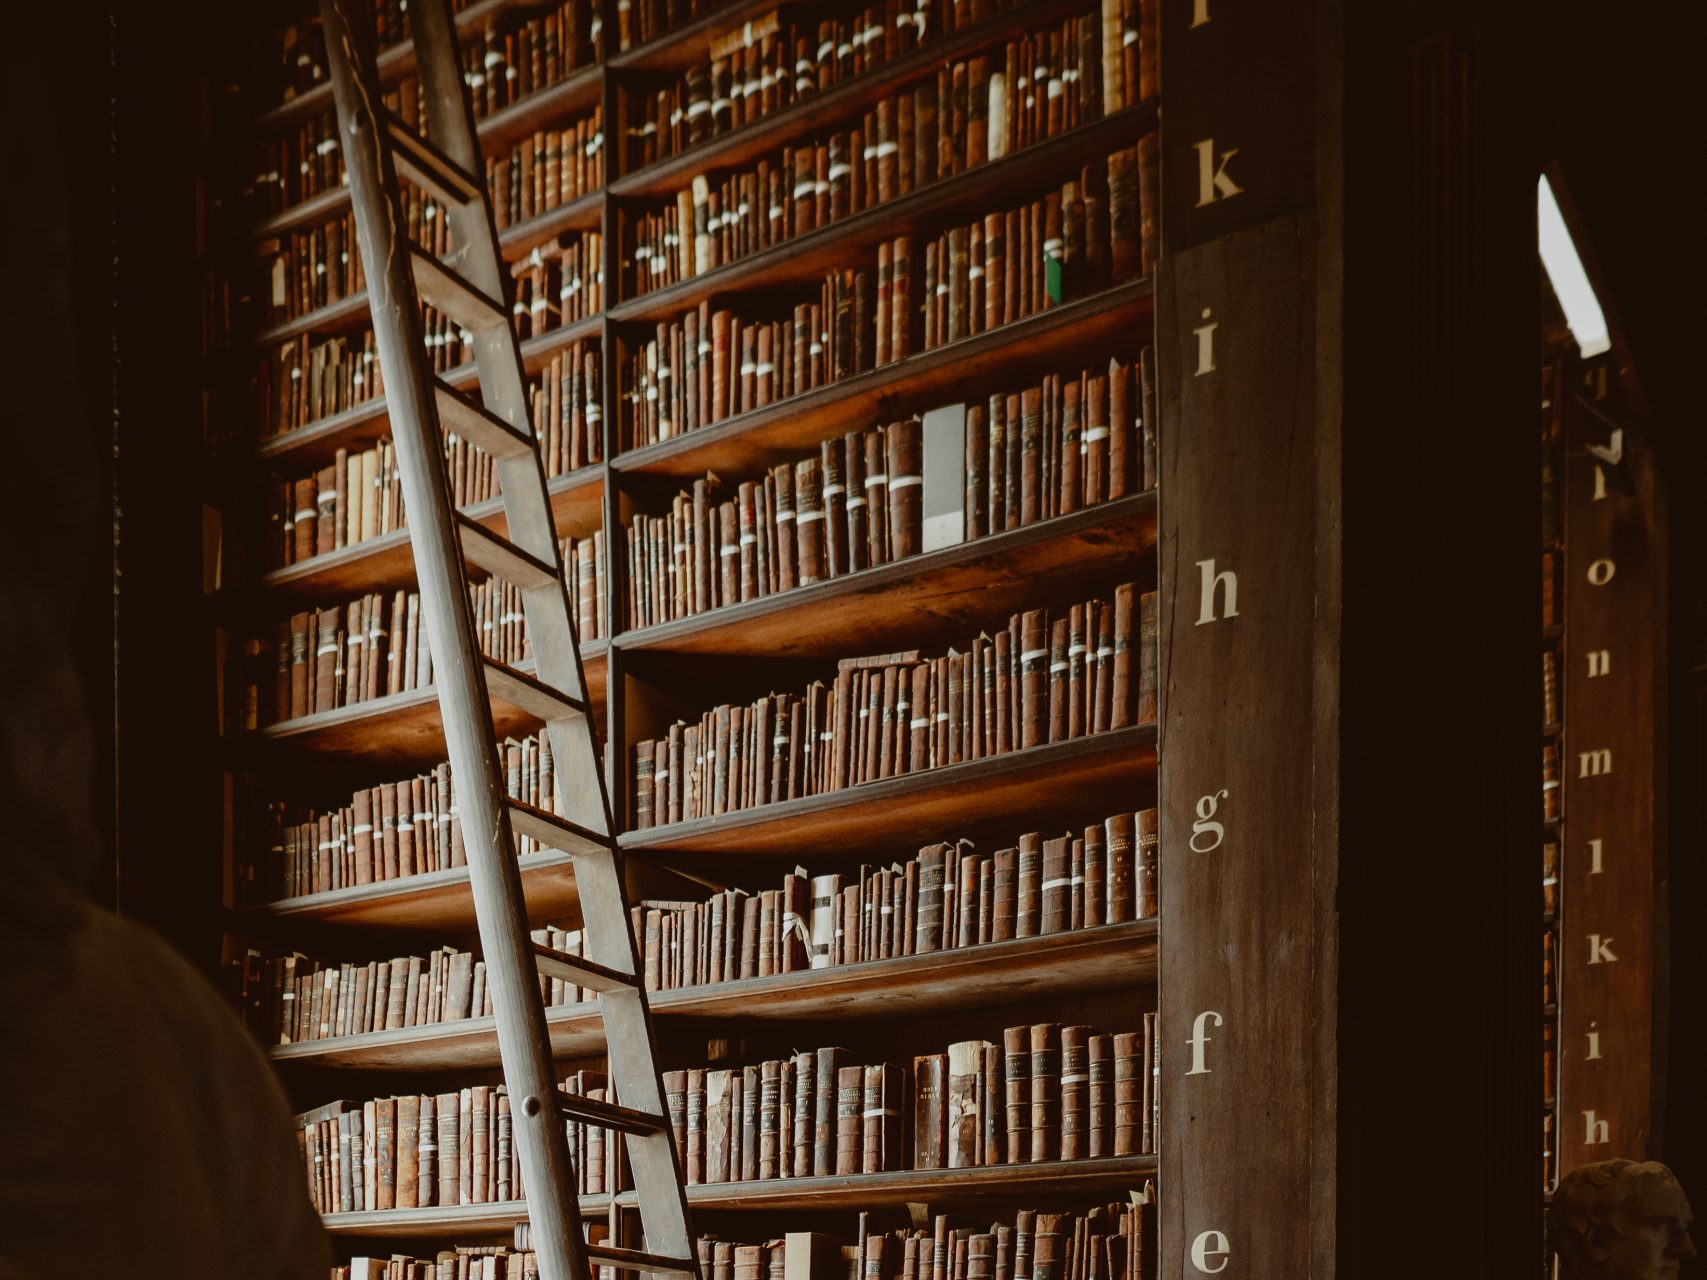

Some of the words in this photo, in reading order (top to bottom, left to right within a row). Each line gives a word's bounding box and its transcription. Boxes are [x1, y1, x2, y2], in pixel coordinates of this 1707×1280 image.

[1192, 137, 1245, 208] k
[1193, 307, 1218, 378] i
[1587, 557, 1616, 586] o
[1194, 558, 1239, 626] h
[1586, 648, 1611, 679] n
[1578, 745, 1612, 779] m
[1189, 789, 1229, 853] g
[1587, 838, 1604, 875] l
[1586, 934, 1619, 965] k
[1185, 1011, 1223, 1076] f
[1585, 1022, 1602, 1061] i
[1583, 1111, 1610, 1145] h
[1191, 1230, 1230, 1274] e
